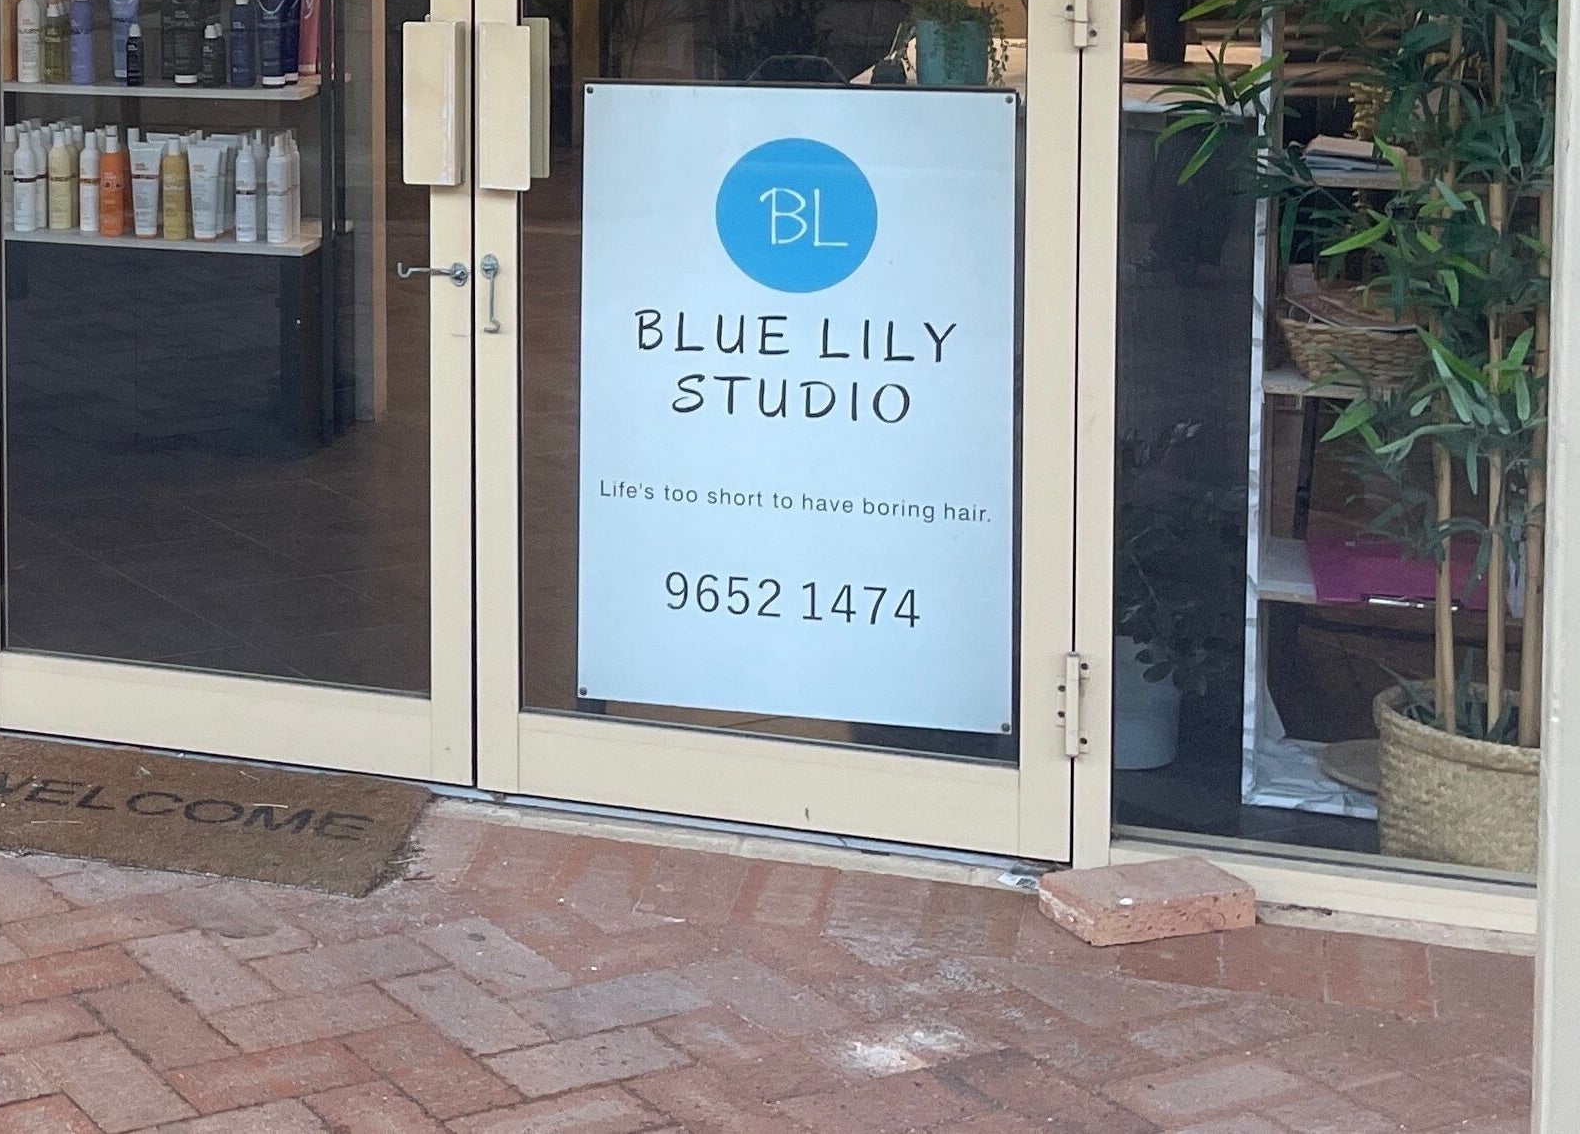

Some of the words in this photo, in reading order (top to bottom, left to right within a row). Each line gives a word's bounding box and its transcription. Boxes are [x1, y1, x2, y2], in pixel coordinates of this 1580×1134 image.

[759, 186, 849, 248] BL
[634, 308, 790, 356] BLUE
[819, 317, 958, 363] LILY
[671, 373, 911, 424] STUDIO
[600, 479, 655, 501] Life's
[663, 485, 699, 504] too
[707, 488, 763, 509] short
[772, 492, 793, 510] to
[801, 493, 854, 514] have
[863, 497, 935, 524] boring
[943, 503, 992, 524] hair.
[665, 570, 783, 619] 9652
[801, 580, 922, 629] 1474
